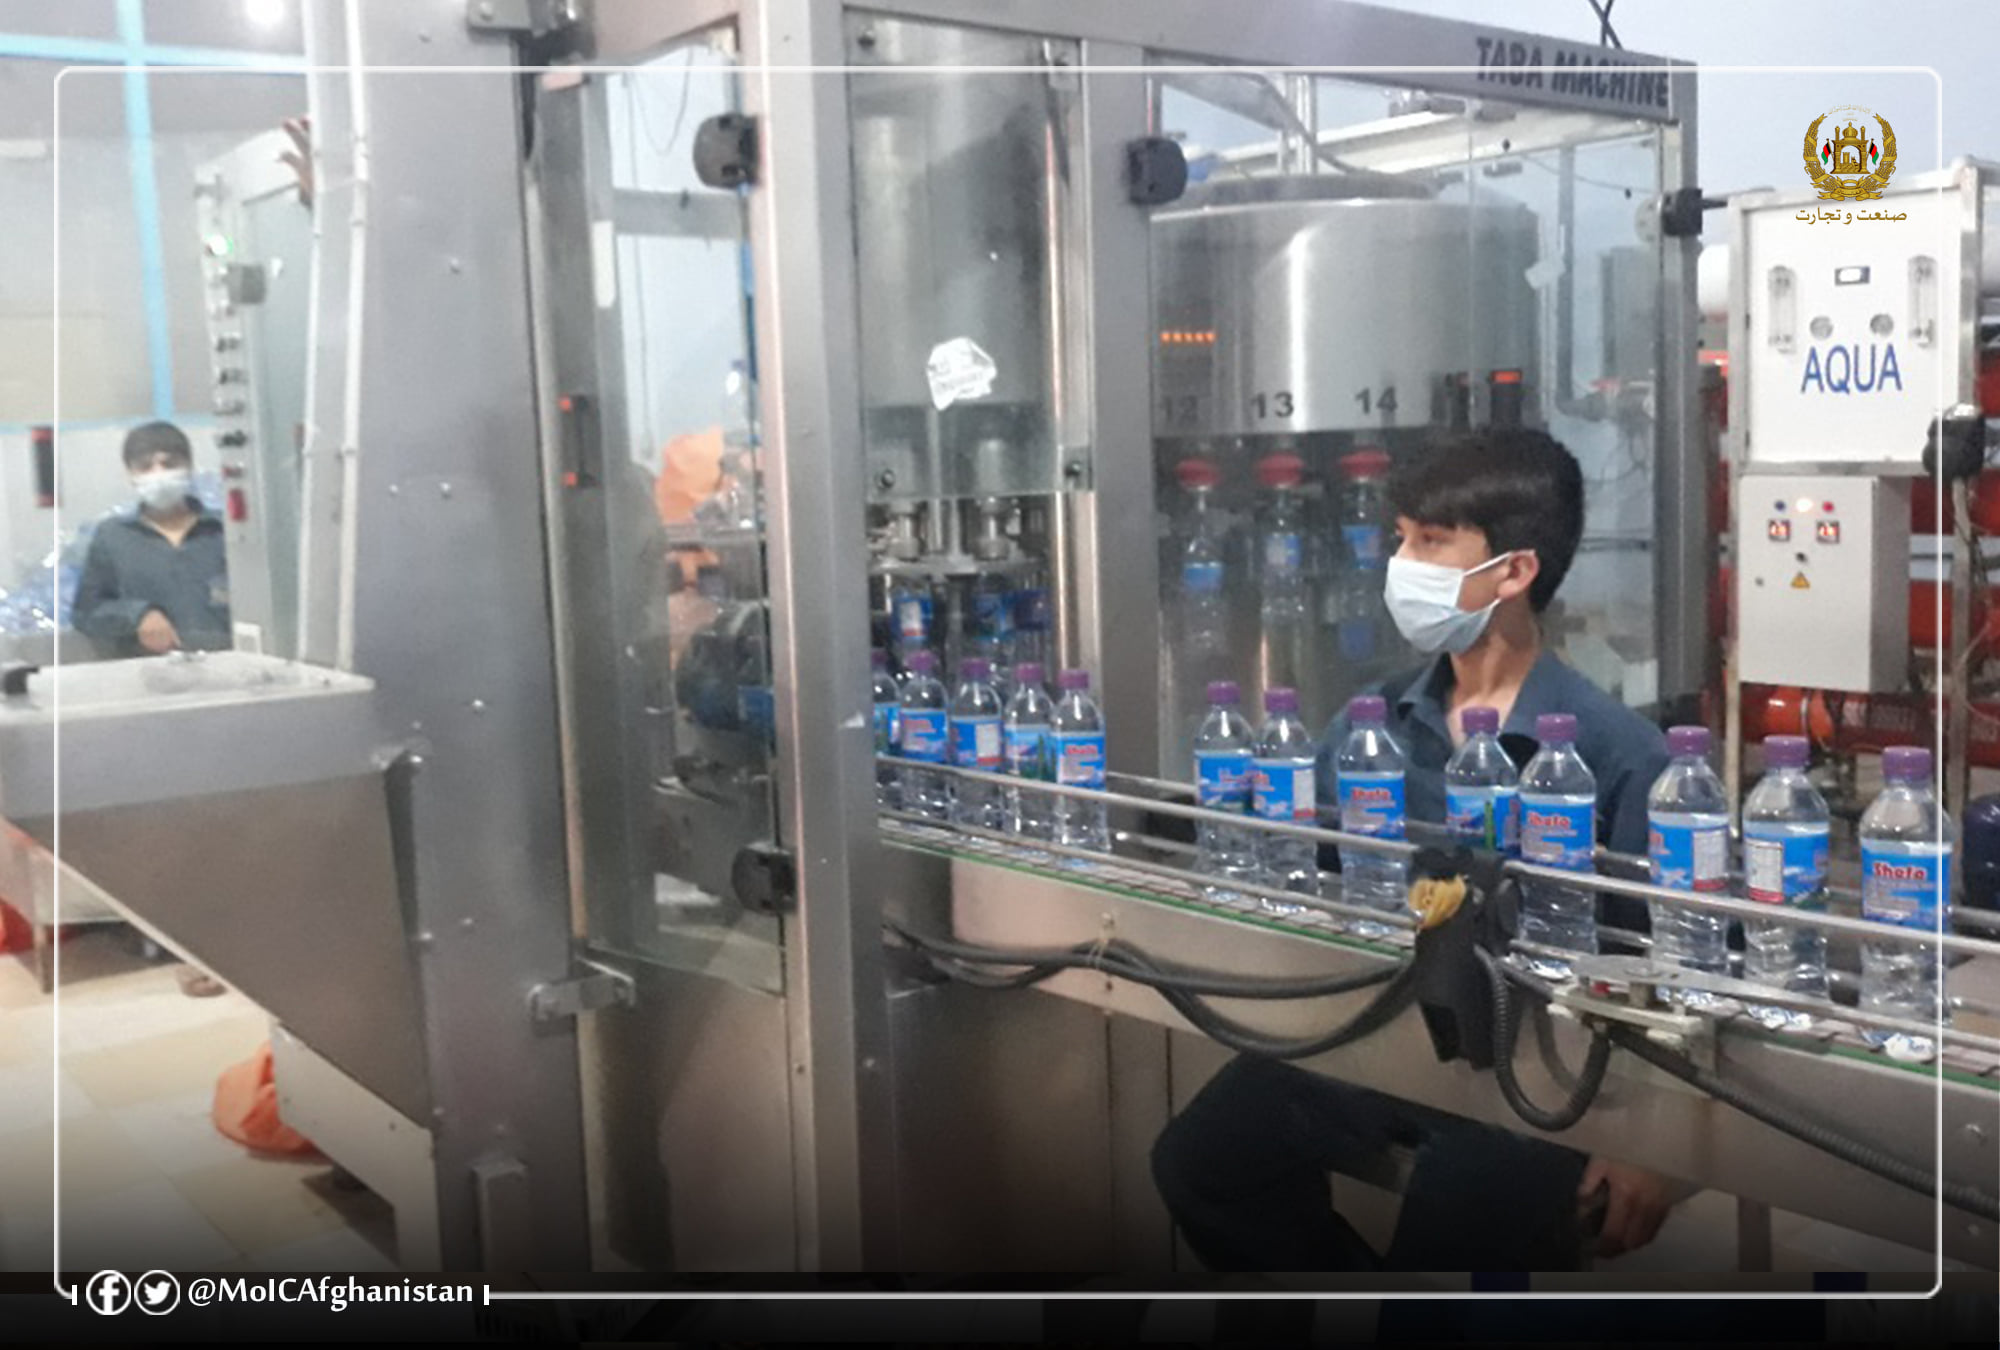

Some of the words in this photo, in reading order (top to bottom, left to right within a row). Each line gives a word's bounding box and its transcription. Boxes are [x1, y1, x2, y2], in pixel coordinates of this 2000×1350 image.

[1551, 50, 1670, 108] MACHINE
[1801, 343, 1902, 394] AQUA
[1250, 391, 1294, 419] 13
[1355, 386, 1399, 415] 14
